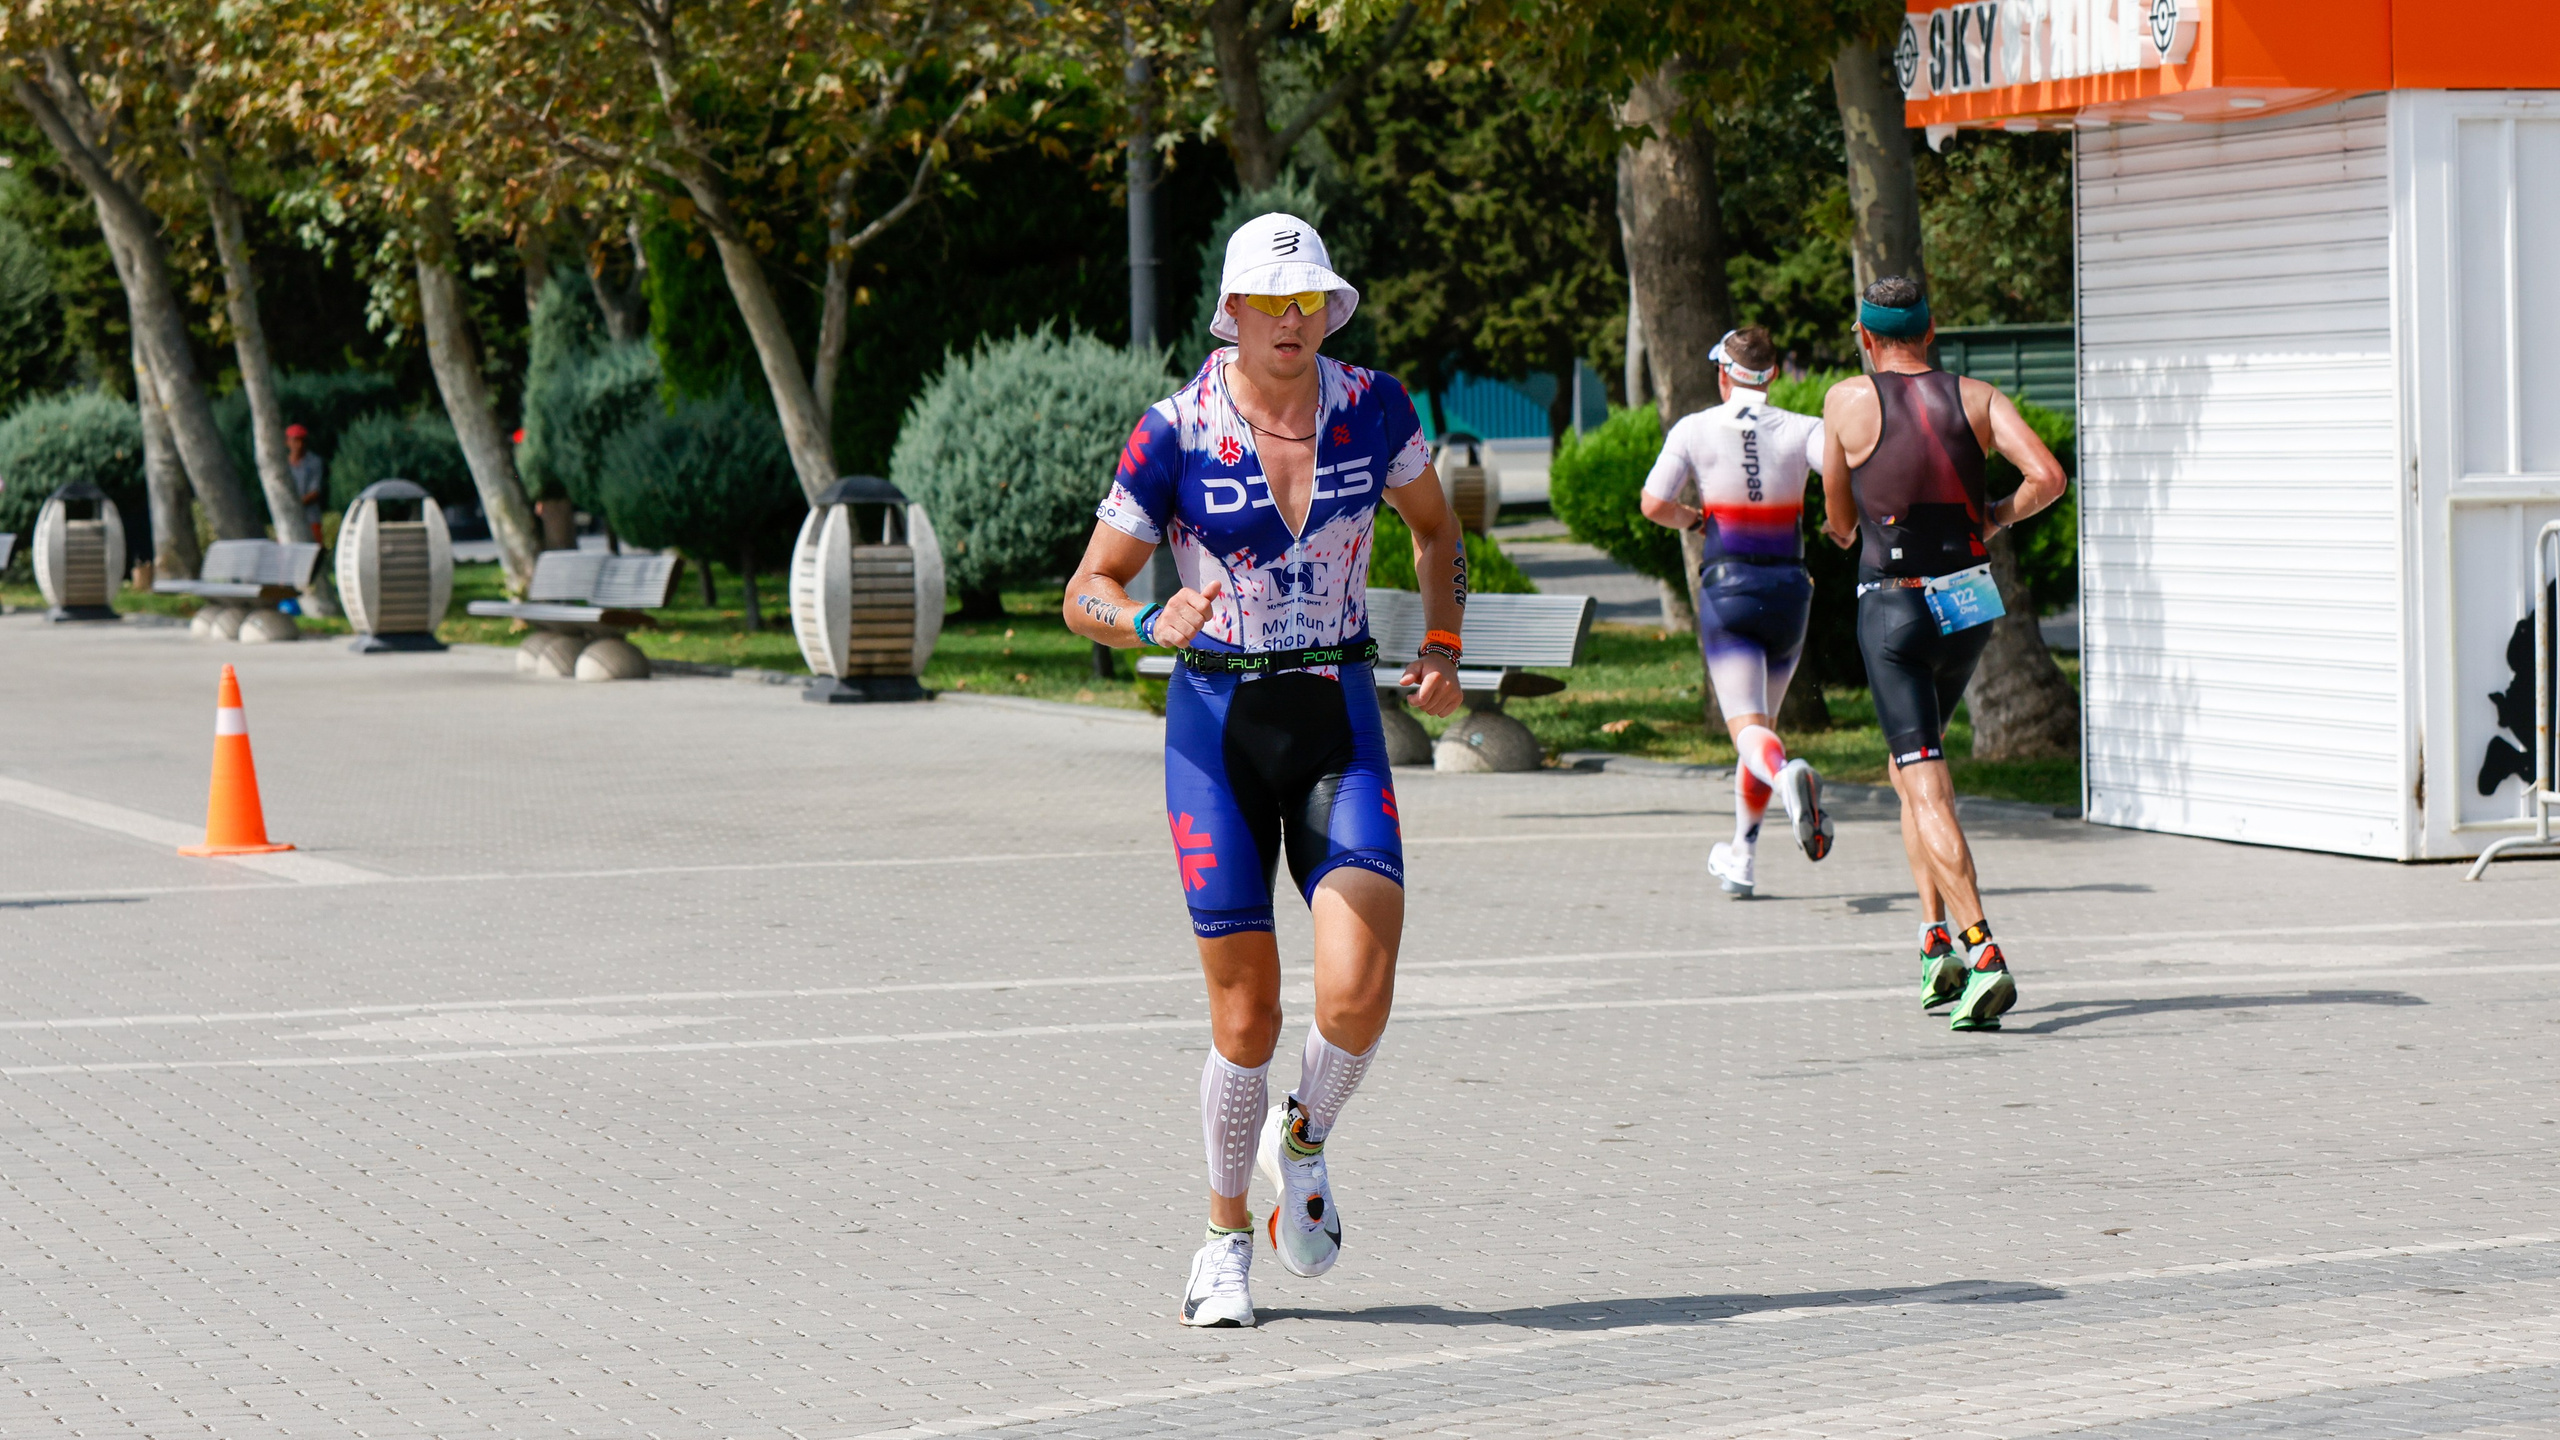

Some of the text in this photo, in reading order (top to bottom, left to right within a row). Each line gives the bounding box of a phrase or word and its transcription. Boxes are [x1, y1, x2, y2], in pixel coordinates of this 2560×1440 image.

[1928, 3, 1998, 94] SKY
[1741, 429, 1763, 502] surpas
[1949, 587, 1978, 607] 122
[1262, 612, 1324, 635] My Run
